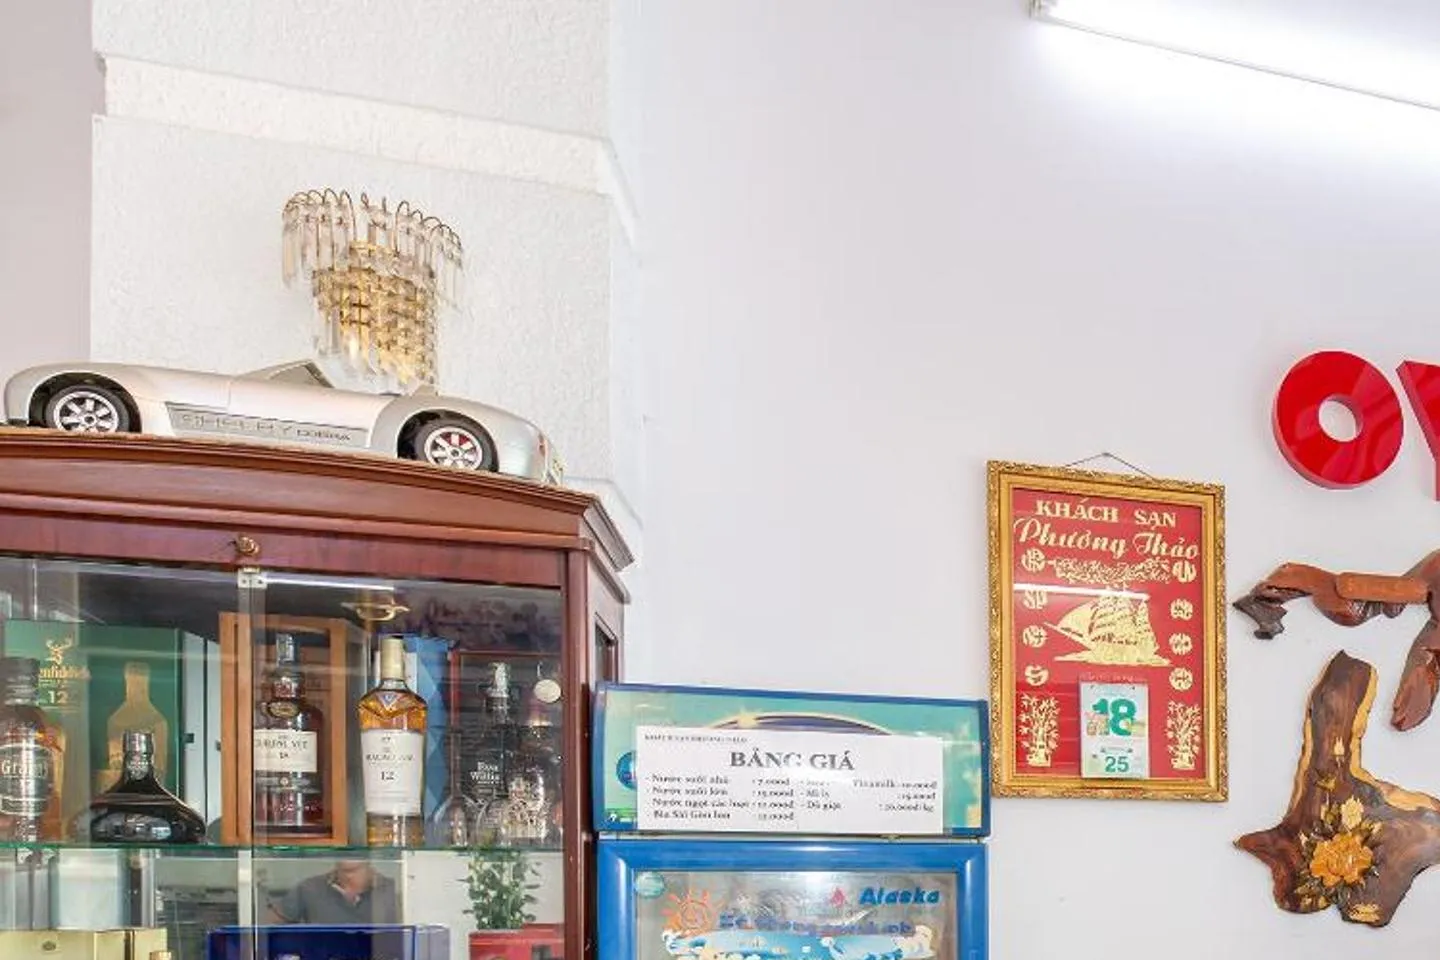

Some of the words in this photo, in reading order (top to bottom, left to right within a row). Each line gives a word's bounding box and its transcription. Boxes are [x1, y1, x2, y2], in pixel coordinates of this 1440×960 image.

[1035, 498, 1119, 523] KHÁCH
[1134, 508, 1176, 530] SẠN
[730, 747, 801, 769] BẢNG
[810, 750, 855, 770] GIÁ
[1105, 756, 1130, 773] 25
[860, 886, 940, 905] Alaska
